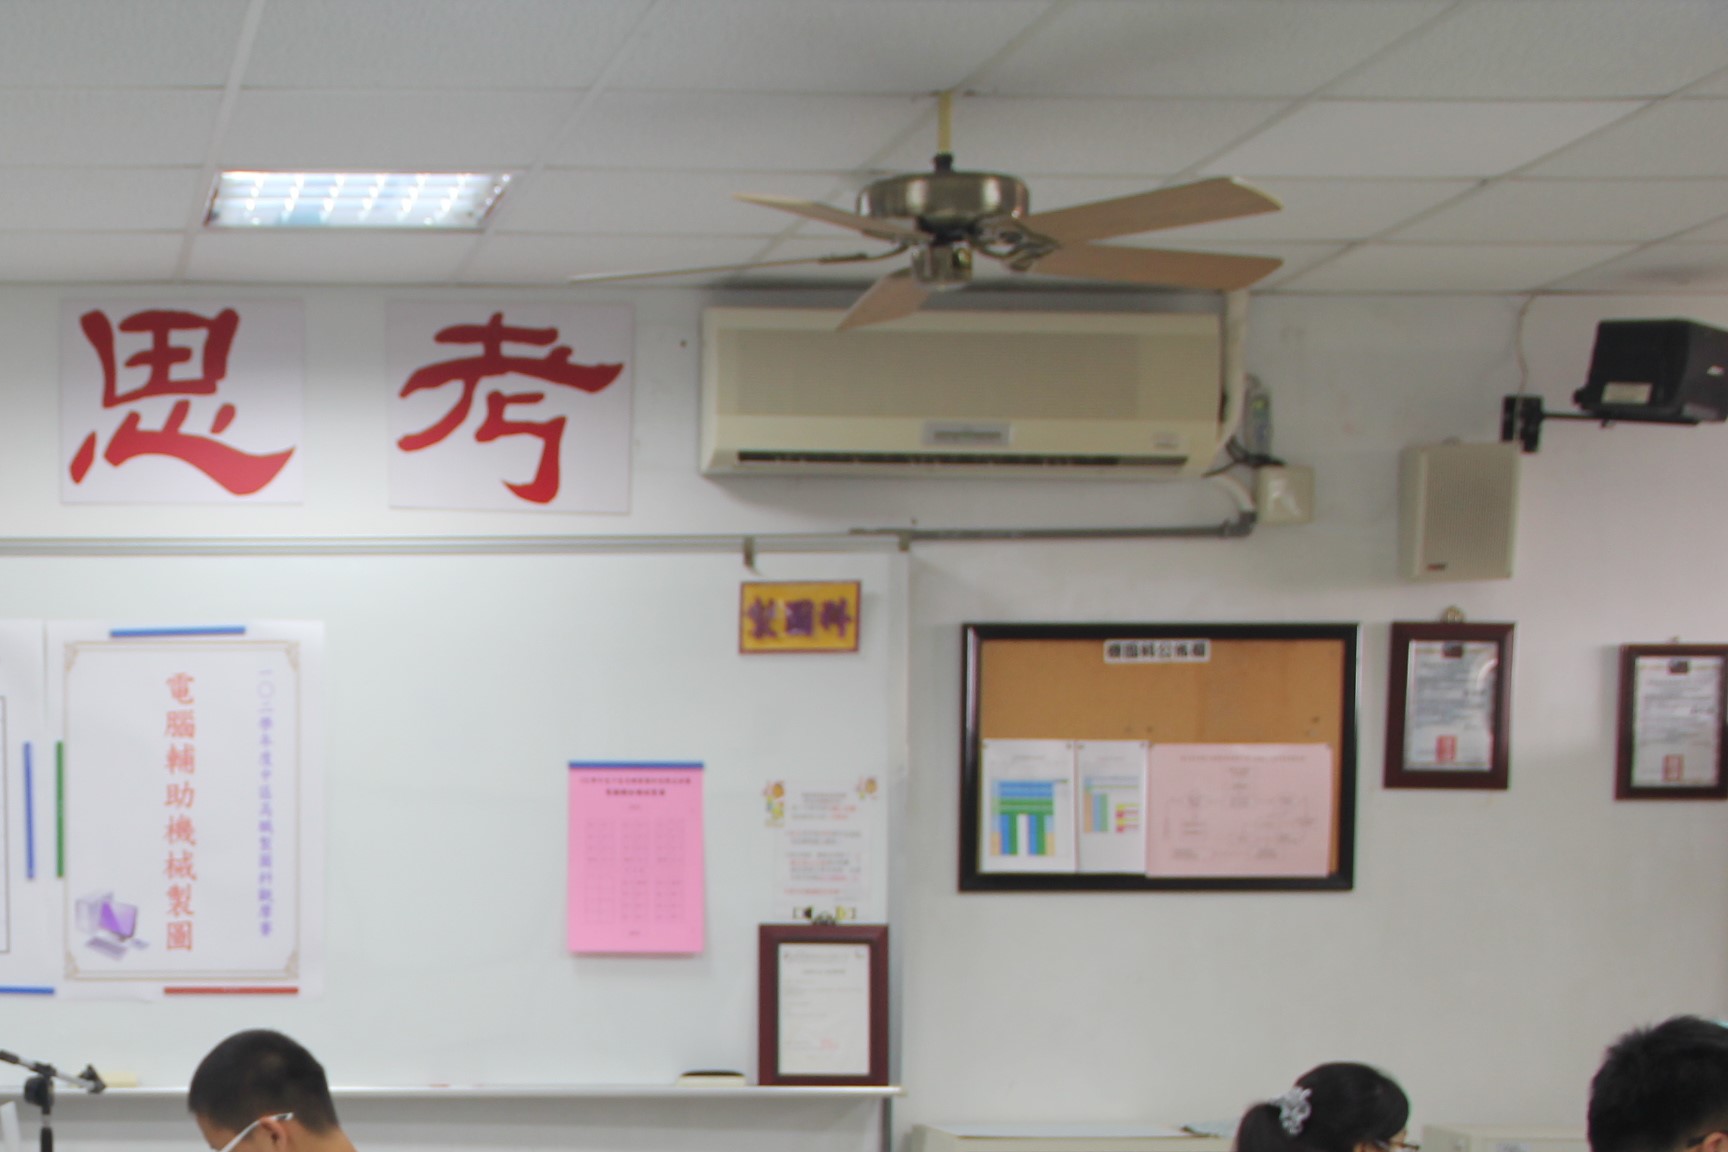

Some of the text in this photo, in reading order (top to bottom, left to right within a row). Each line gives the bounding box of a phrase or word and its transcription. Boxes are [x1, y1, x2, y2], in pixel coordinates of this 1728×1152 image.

[163, 671, 198, 951] 電腦輔助機械製圖
